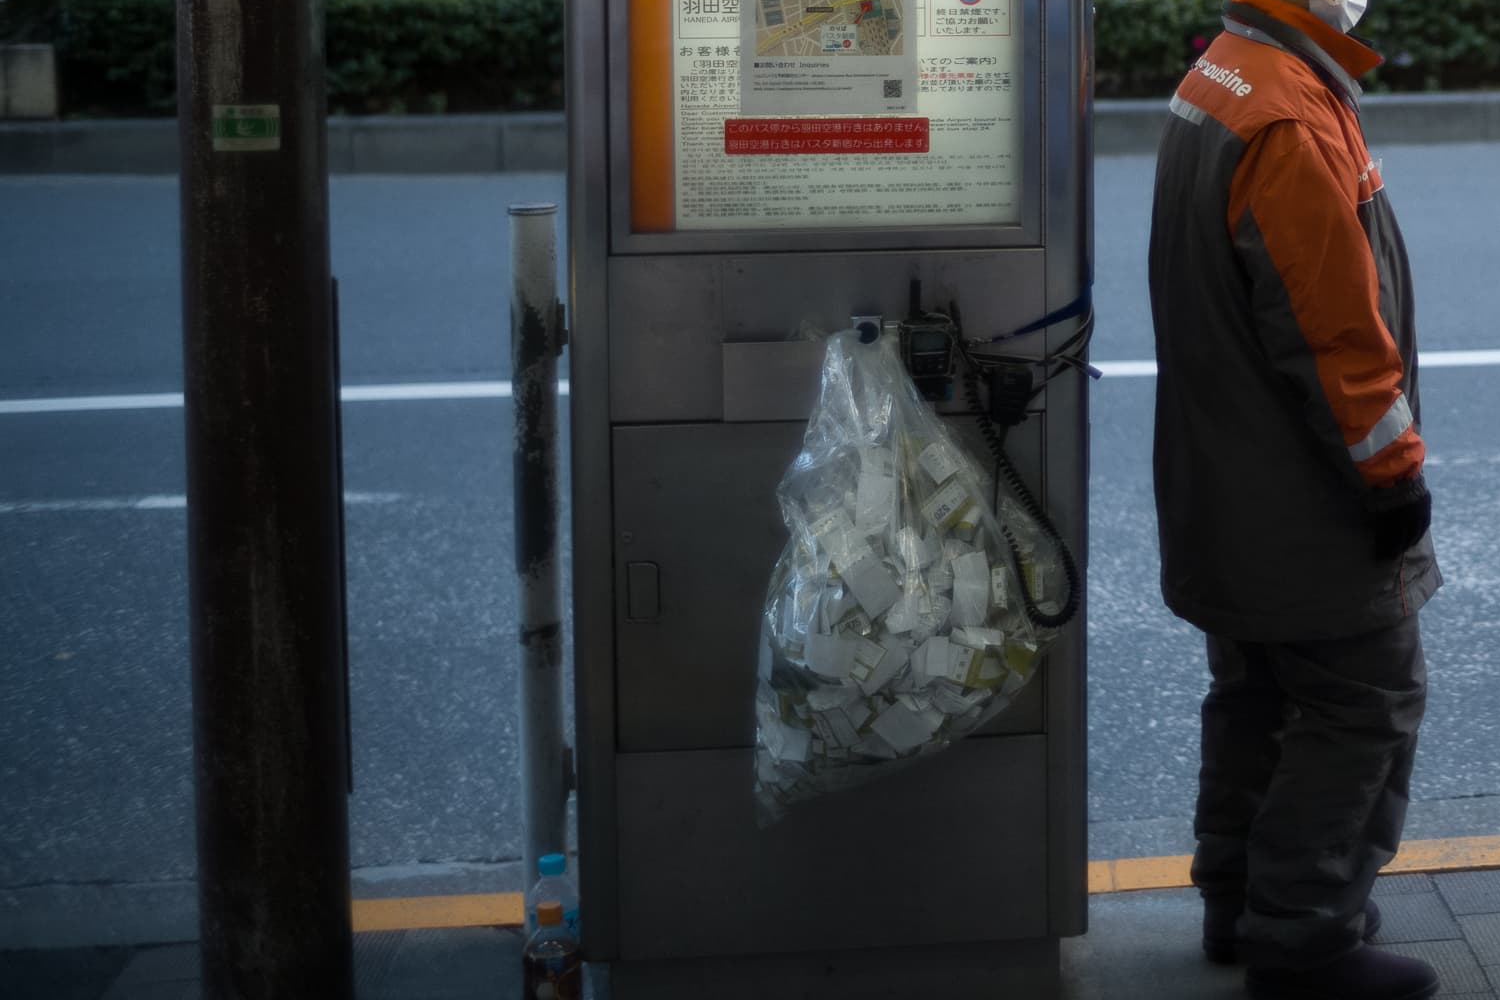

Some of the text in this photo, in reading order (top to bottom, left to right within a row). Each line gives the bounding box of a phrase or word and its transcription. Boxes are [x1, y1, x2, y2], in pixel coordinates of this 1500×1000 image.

[684, 16, 719, 24] HANEDA
[728, 122, 928, 134] このバス停から羽田空港行きはありません。
